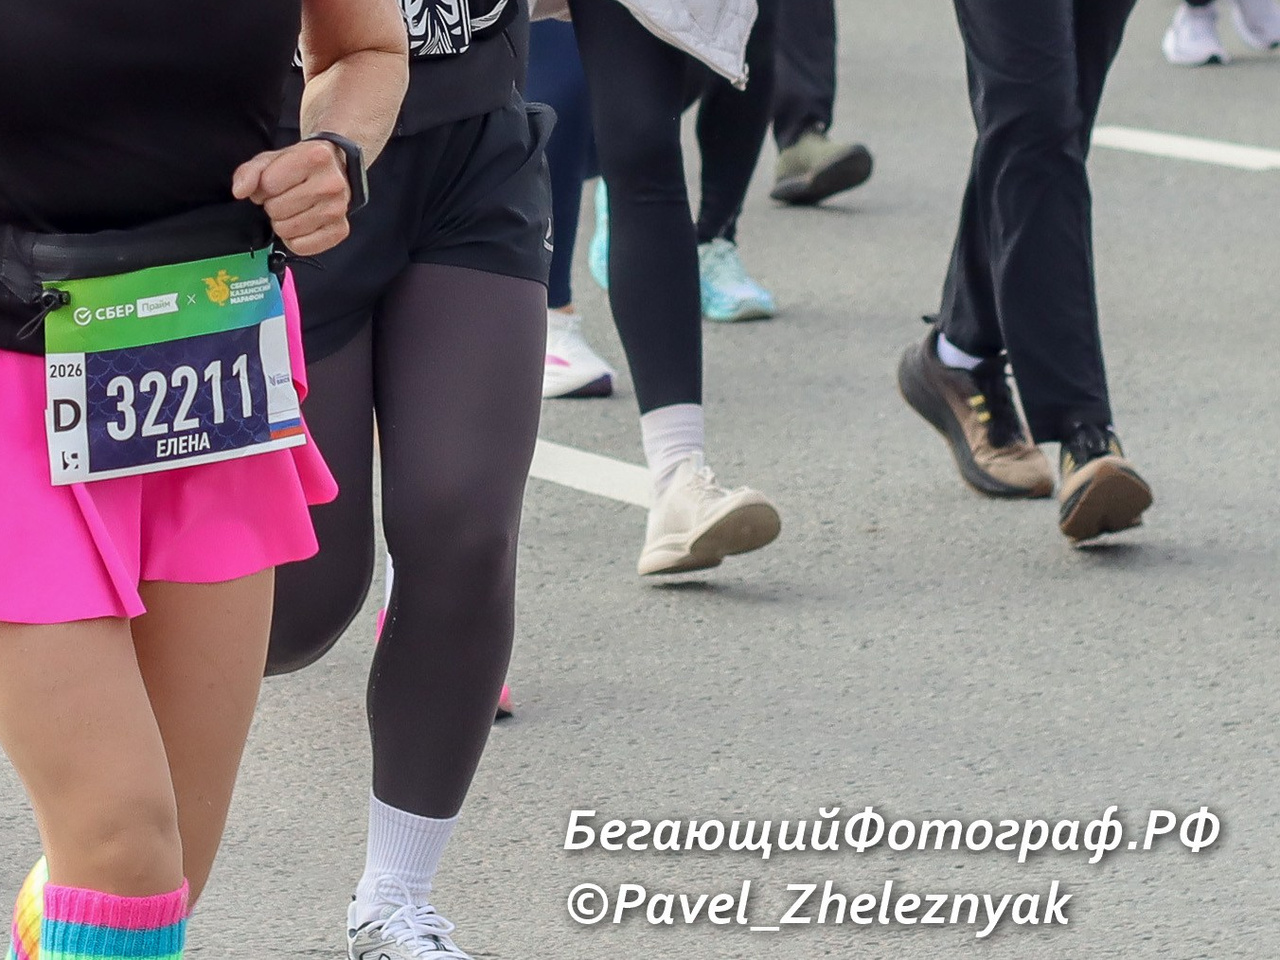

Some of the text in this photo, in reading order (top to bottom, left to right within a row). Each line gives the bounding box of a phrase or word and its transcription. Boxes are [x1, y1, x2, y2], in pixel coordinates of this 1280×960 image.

[95, 298, 172, 321] СБЕР Прайм
[50, 364, 82, 378] 2026
[106, 353, 252, 441] 32211
[53, 399, 81, 433] D
[156, 432, 211, 458] ЕЛЕНА
